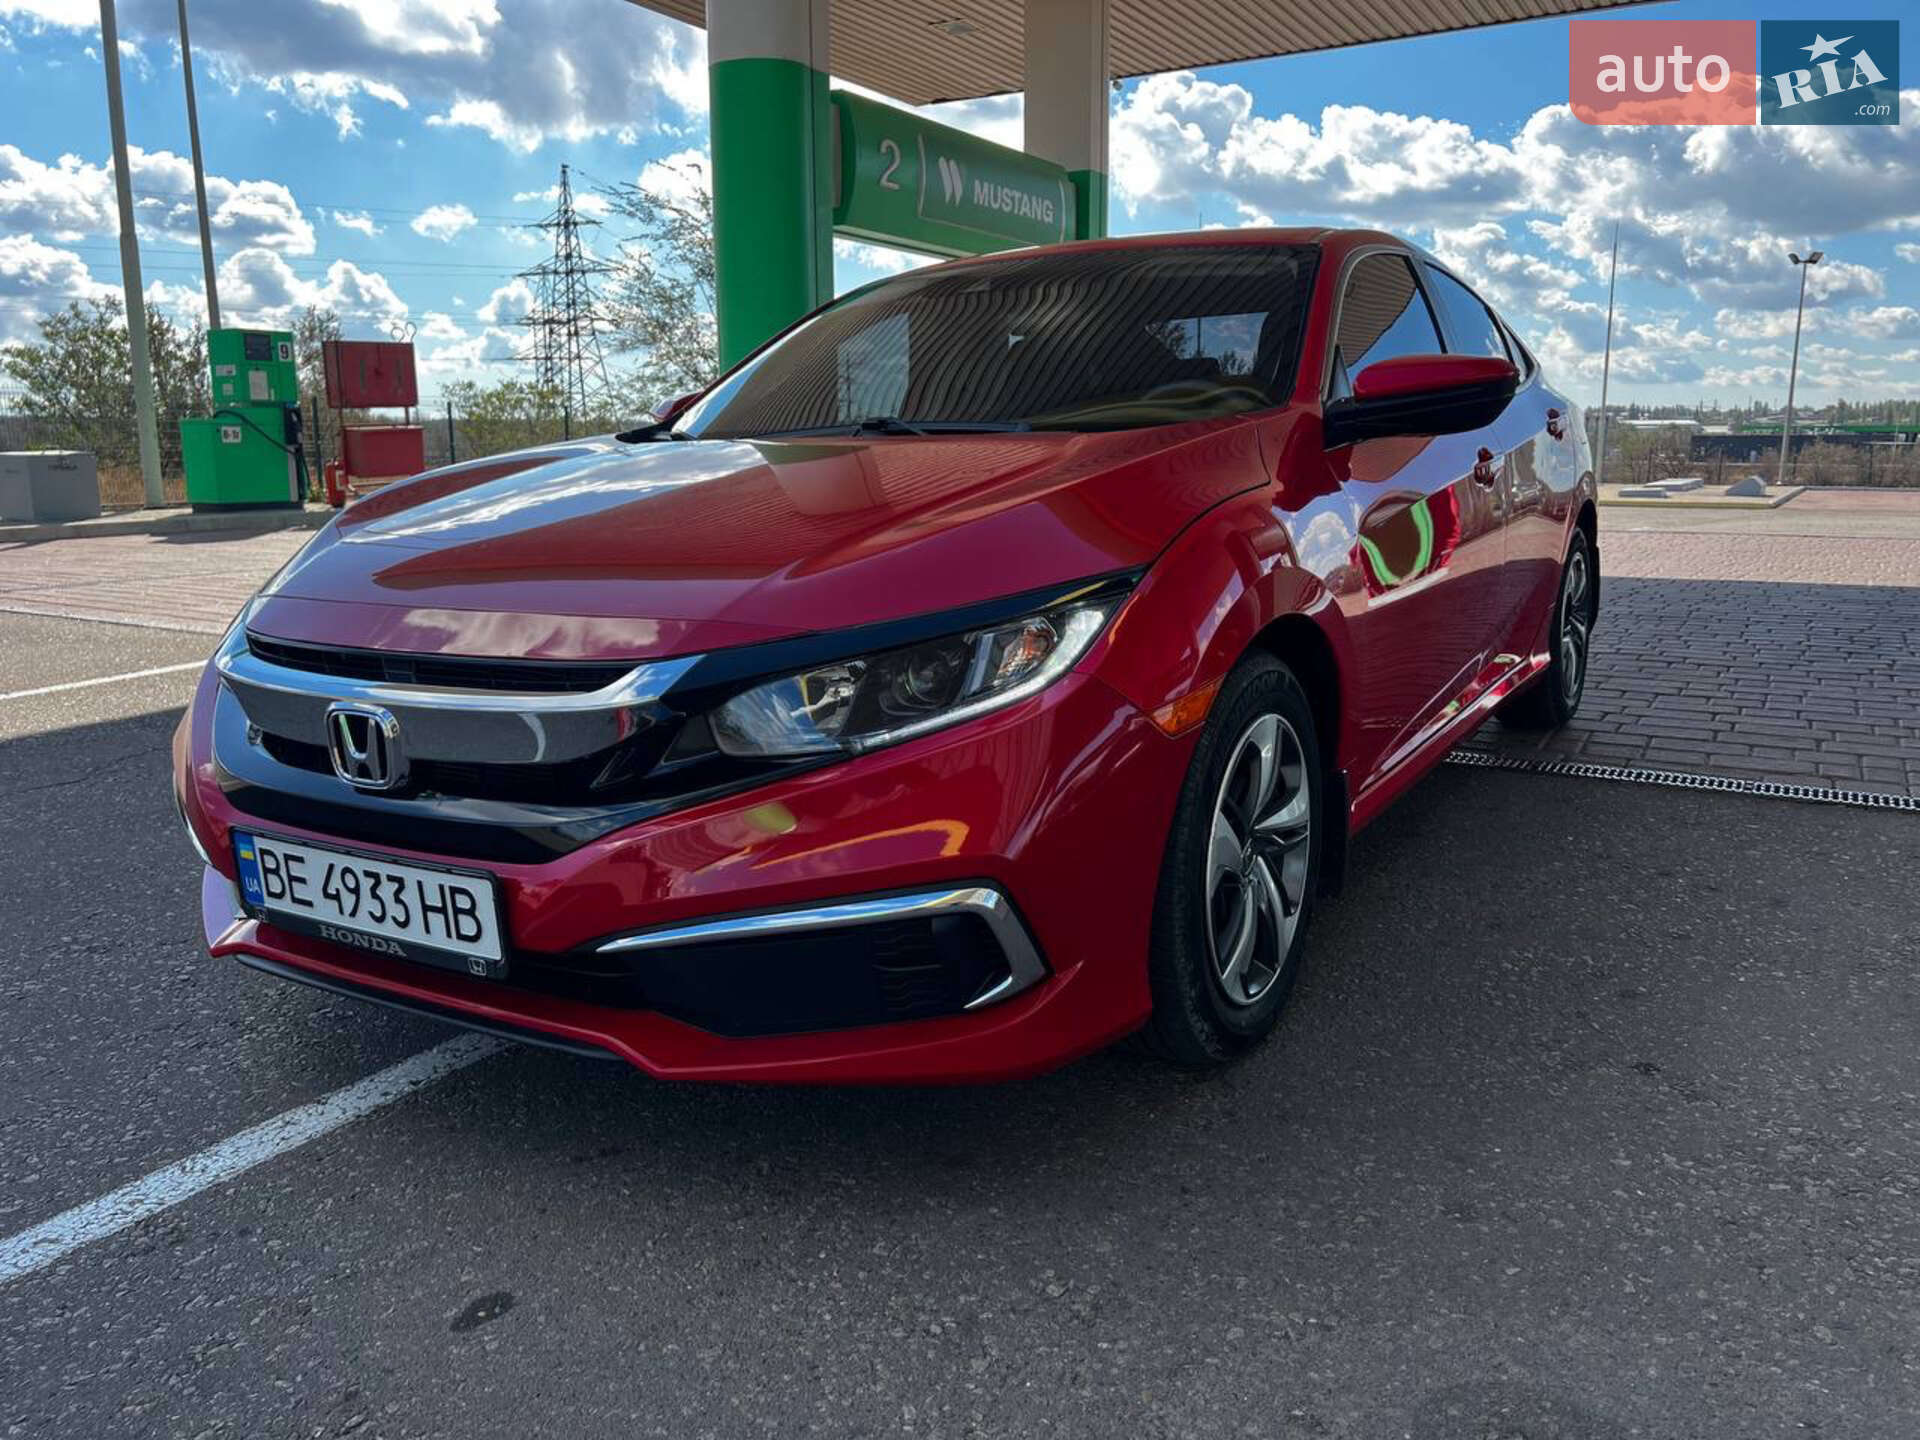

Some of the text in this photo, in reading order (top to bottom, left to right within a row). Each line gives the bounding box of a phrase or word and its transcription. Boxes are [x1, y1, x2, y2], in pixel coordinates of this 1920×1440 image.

[879, 138, 902, 190] 2
[972, 179, 1055, 224] MUSTANG
[279, 343, 289, 360] 9
[244, 876, 262, 895] UA
[258, 847, 483, 943] BE 4933 HB
[320, 925, 407, 957] HONDA
